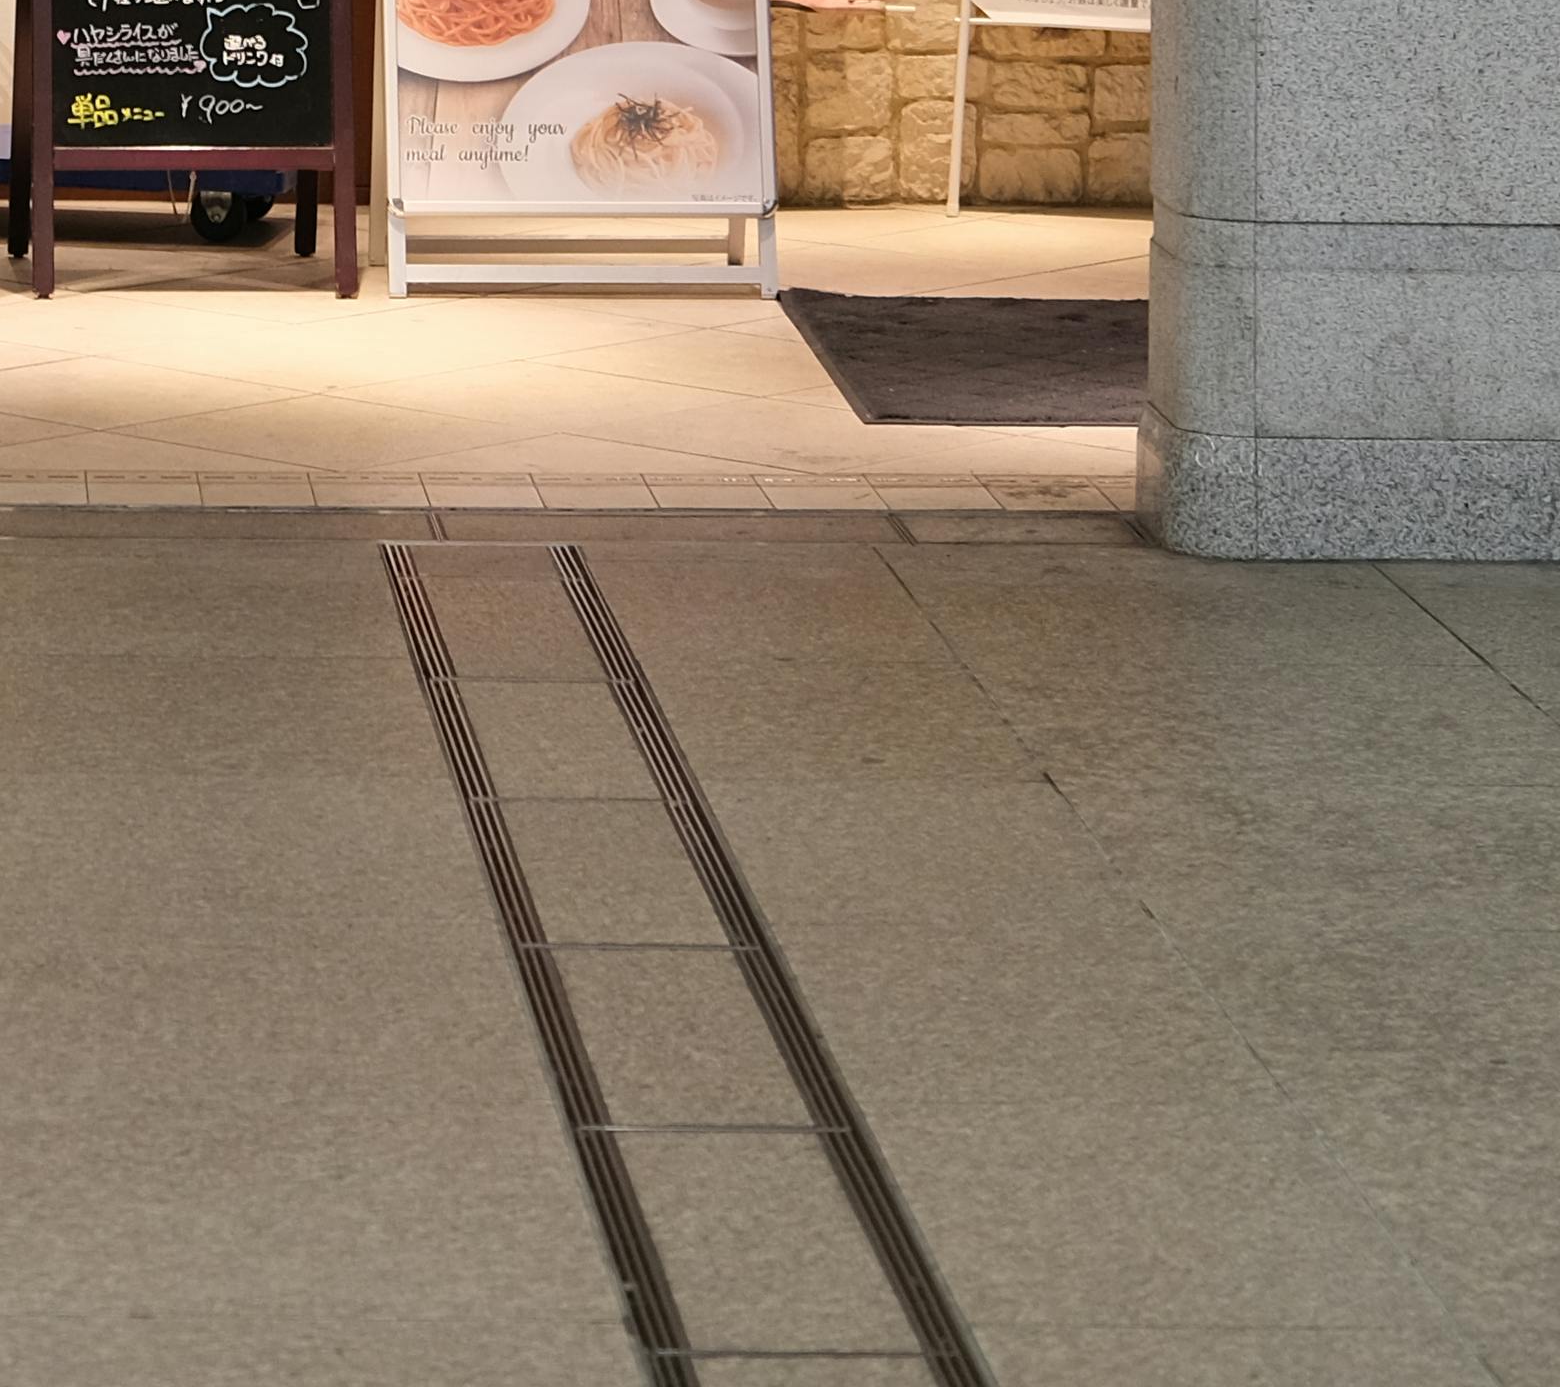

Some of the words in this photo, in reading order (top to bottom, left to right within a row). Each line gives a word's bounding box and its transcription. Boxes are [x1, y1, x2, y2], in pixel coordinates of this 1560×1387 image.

[74, 22, 179, 43] ハヤシライスが
[75, 45, 199, 67] 具だくさんになりました
[406, 115, 458, 138] Please
[472, 119, 514, 144] enjoy
[528, 121, 567, 144] your
[406, 147, 445, 163] meal
[458, 146, 529, 169] anytime!
